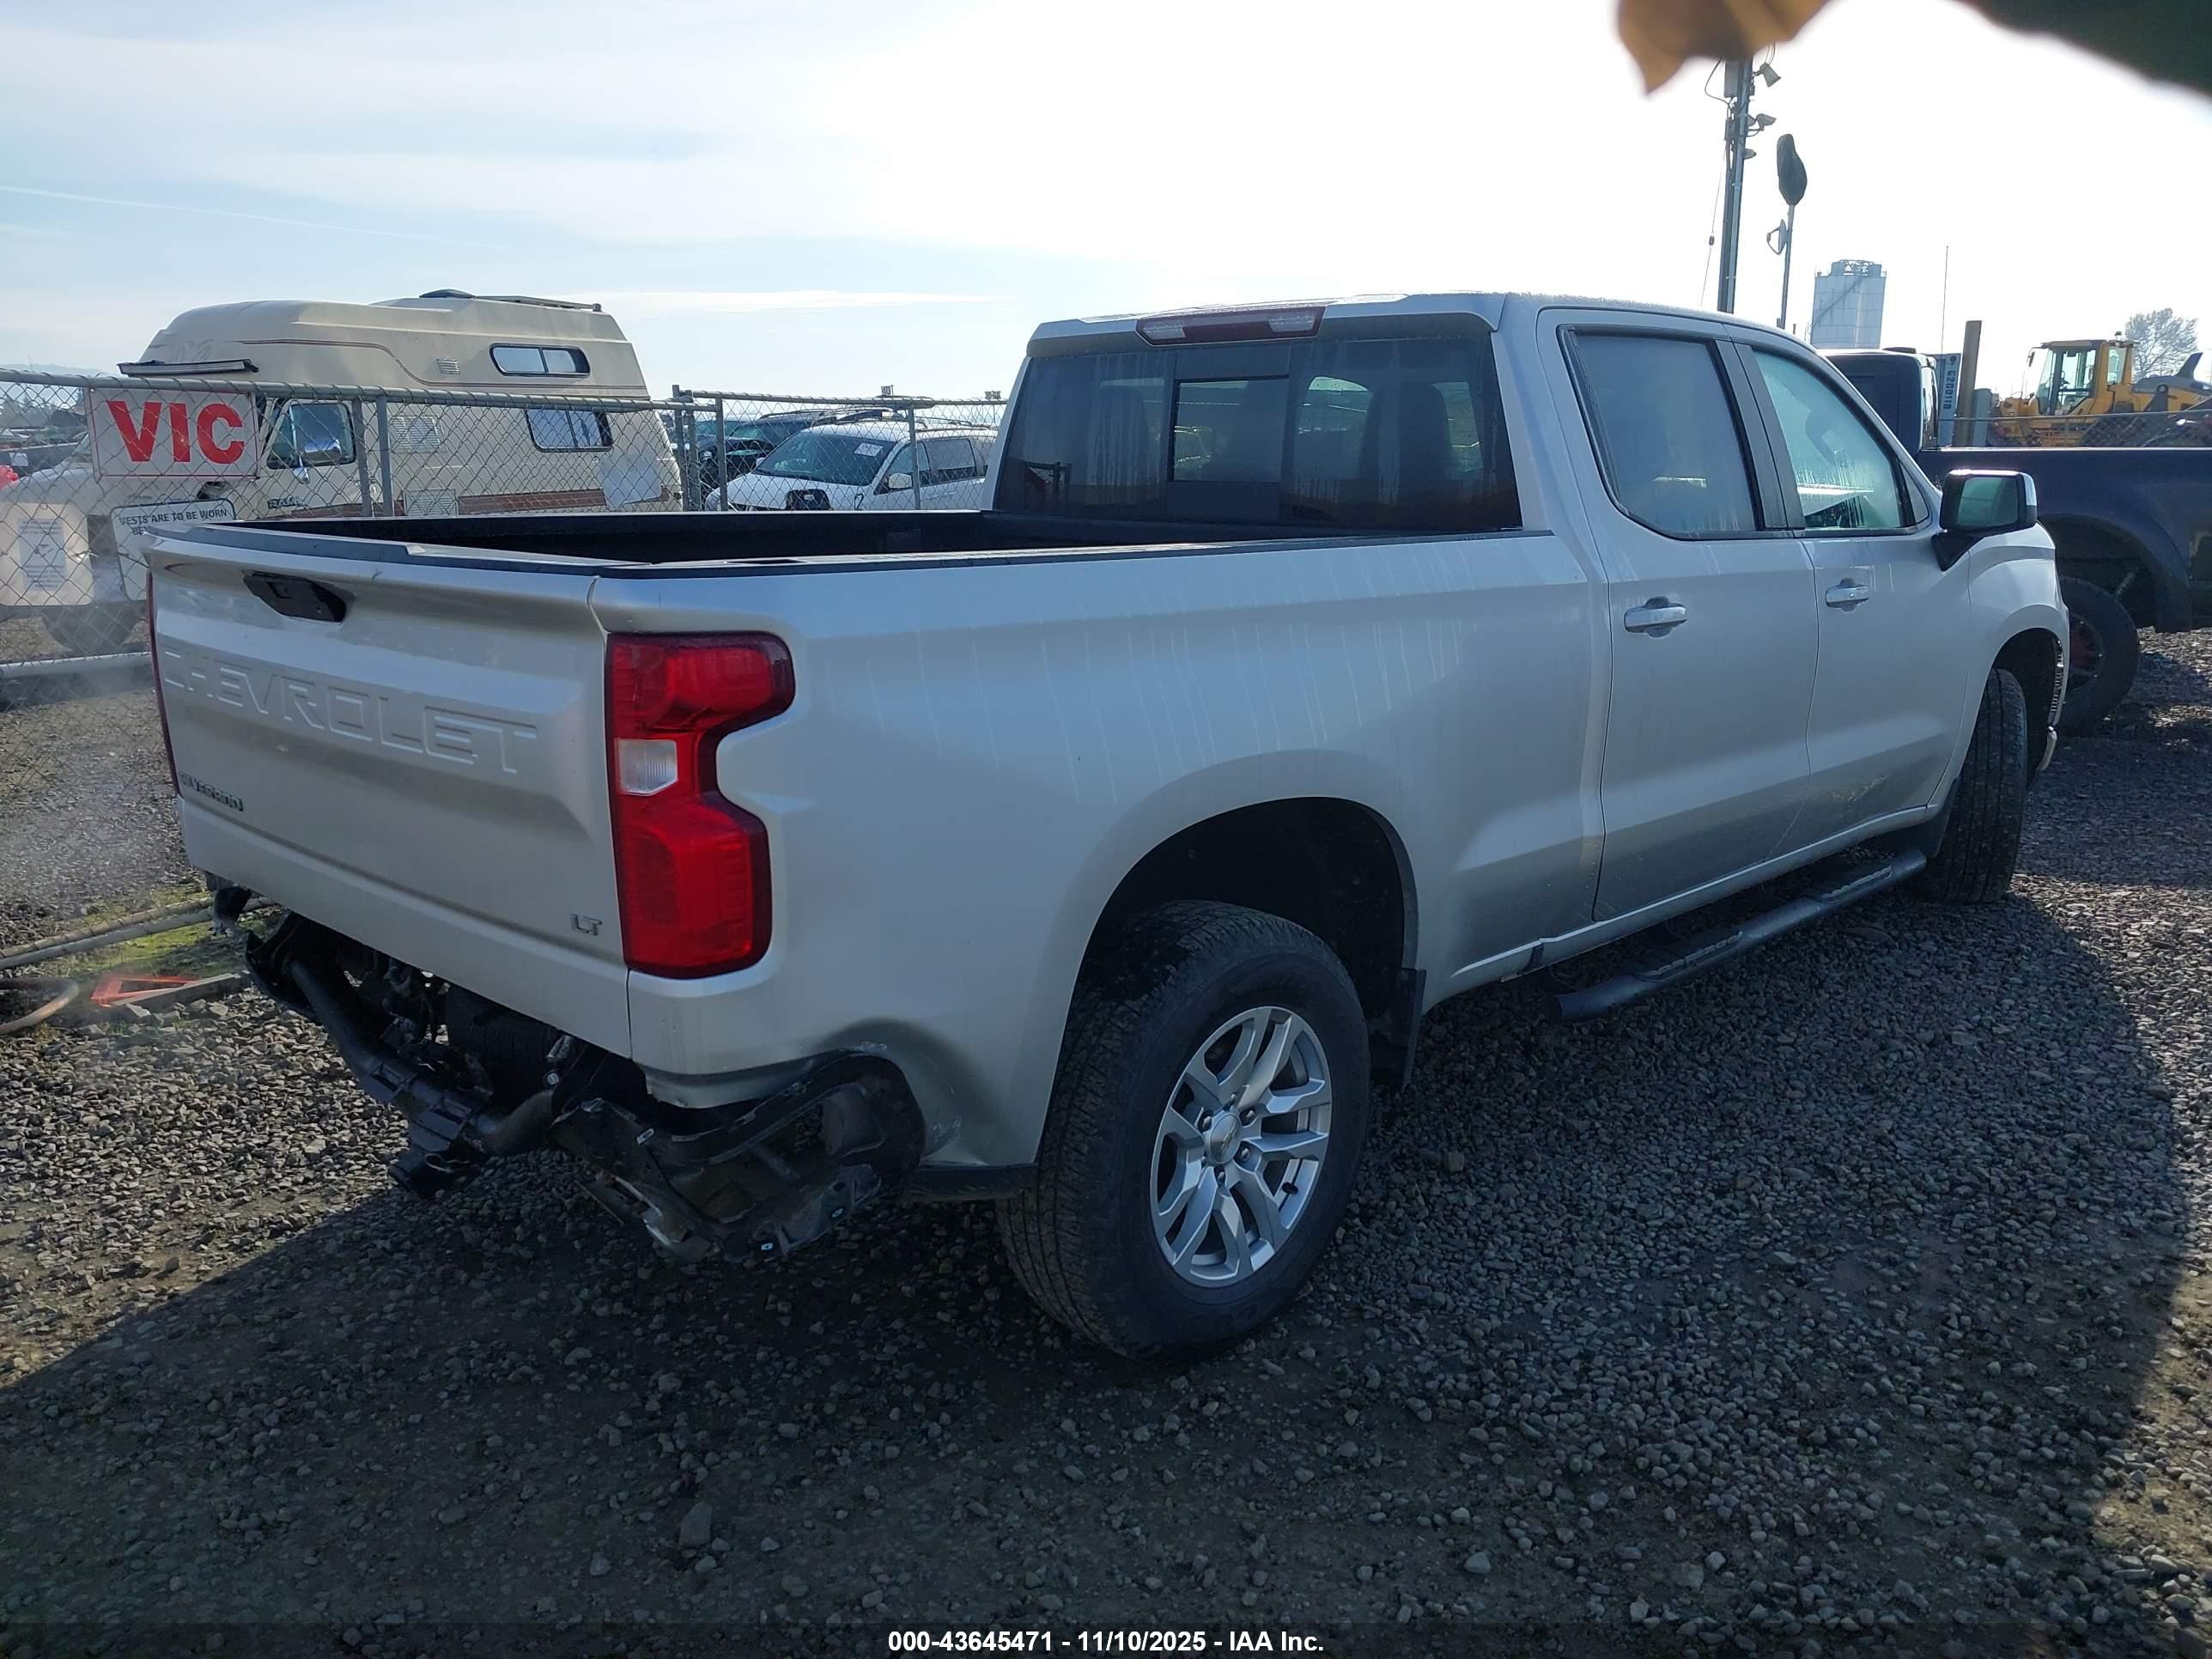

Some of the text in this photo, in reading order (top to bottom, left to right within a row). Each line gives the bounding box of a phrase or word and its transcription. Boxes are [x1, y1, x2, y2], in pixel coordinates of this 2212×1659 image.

[106, 399, 246, 465] VIC
[118, 509, 228, 526] VESTS ARE TO BE WORN
[158, 645, 538, 775] CHEVROLET
[569, 913, 603, 936] LT
